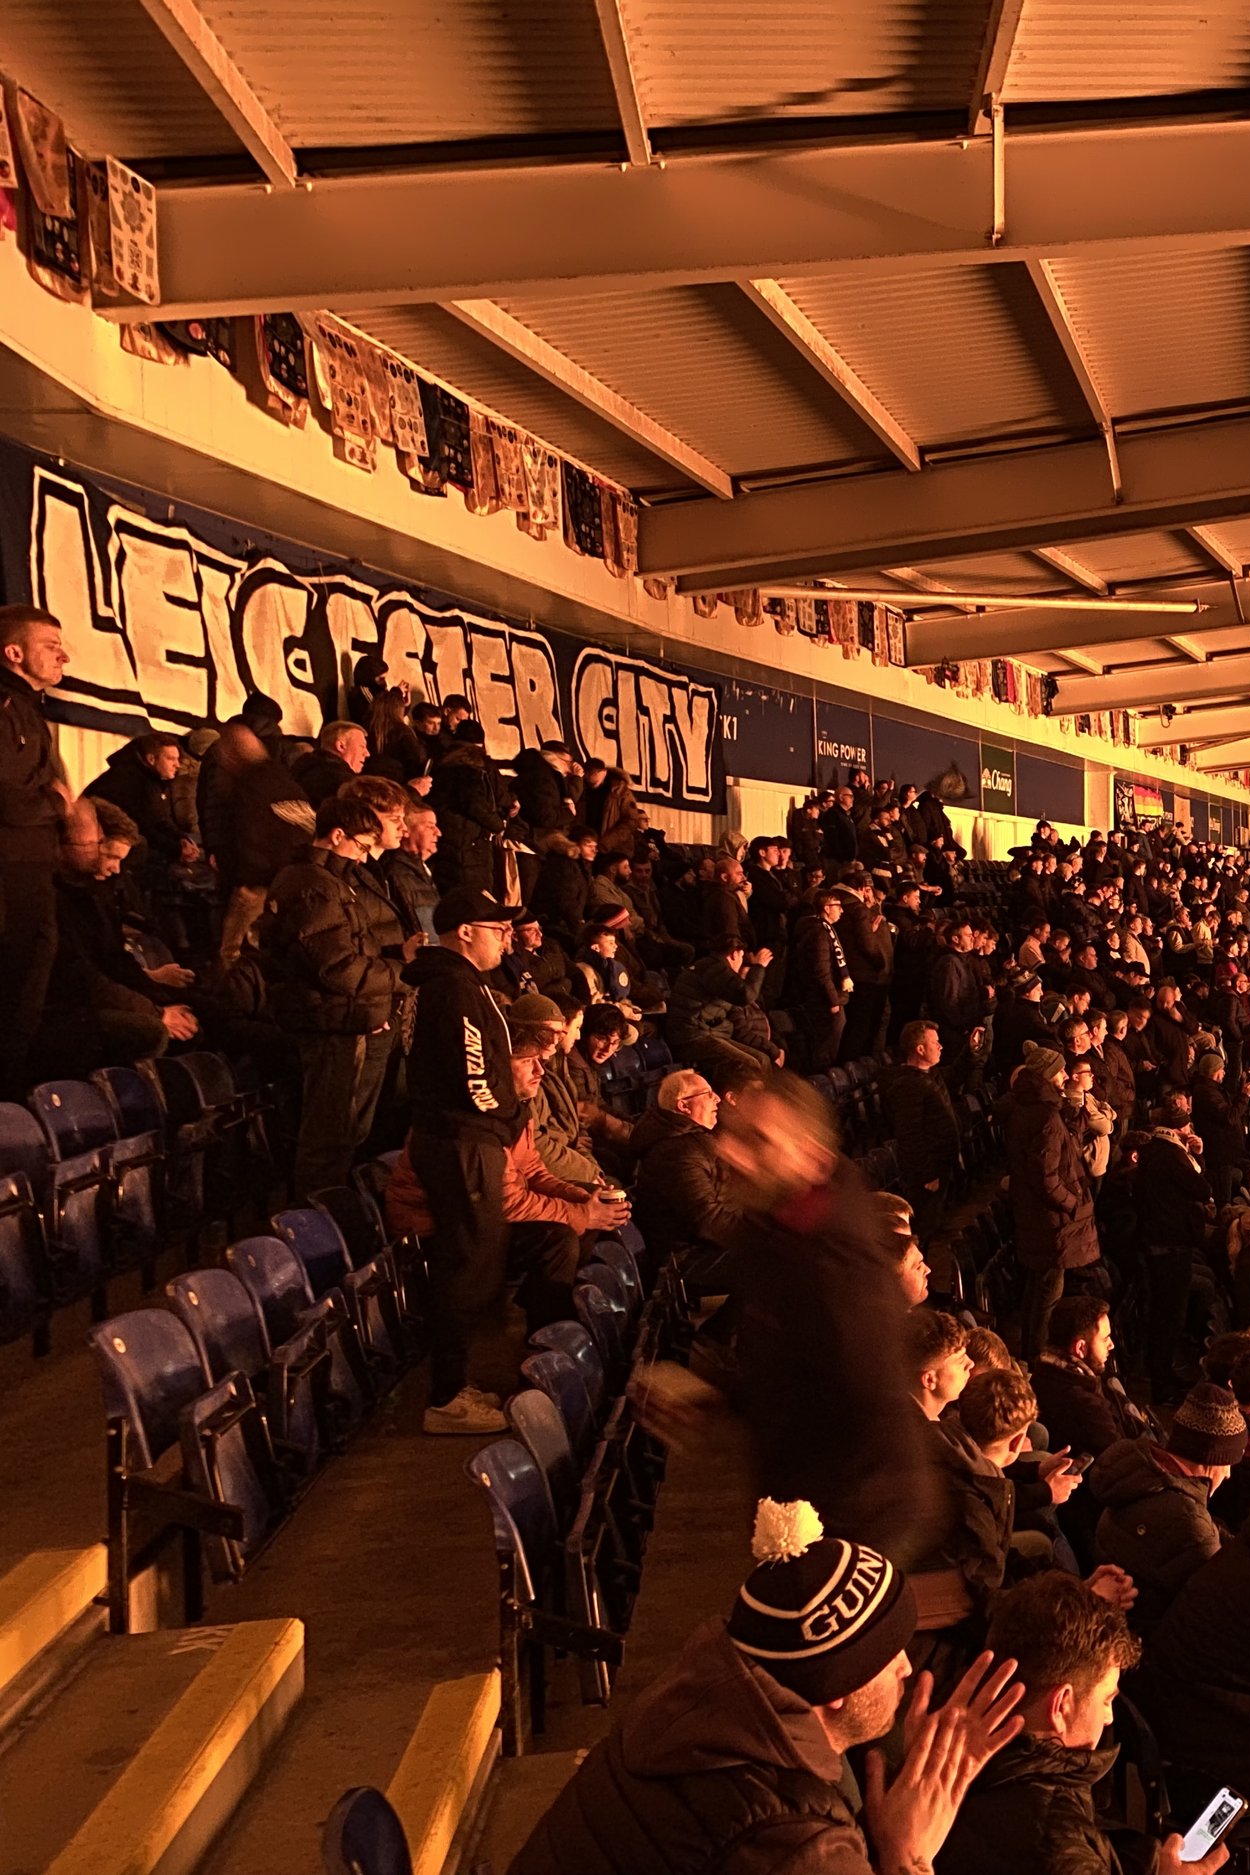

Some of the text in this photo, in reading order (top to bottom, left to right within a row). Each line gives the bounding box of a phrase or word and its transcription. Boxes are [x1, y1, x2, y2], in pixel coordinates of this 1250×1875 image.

[571, 647, 718, 803] CITY
[719, 714, 739, 741] K1
[818, 739, 867, 763] KING POWER
[992, 769, 1012, 797] Chang
[463, 1015, 485, 1076] SANTA
